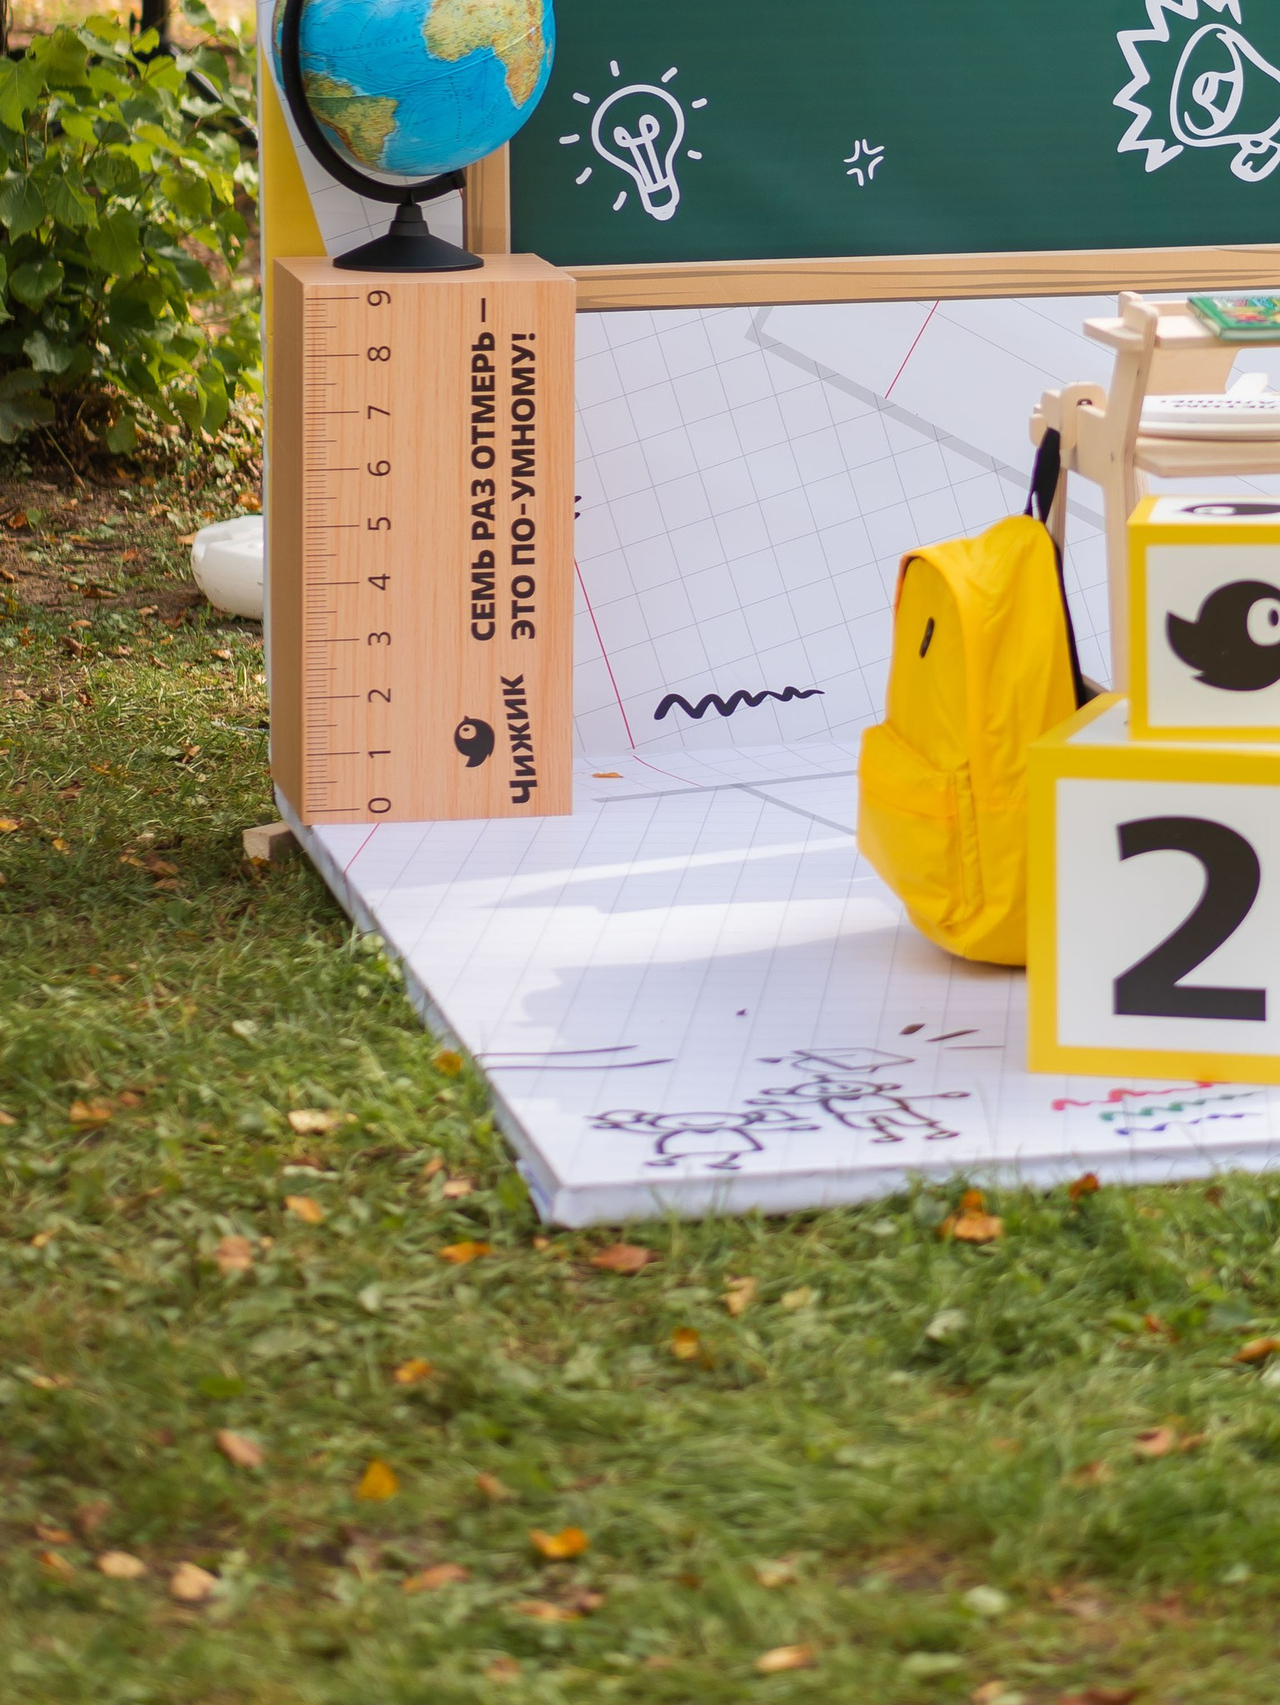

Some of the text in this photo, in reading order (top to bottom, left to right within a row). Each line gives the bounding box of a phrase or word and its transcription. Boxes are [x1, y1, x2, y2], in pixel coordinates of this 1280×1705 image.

[471, 331, 496, 470] ОТМЕРЬ
[511, 332, 536, 640] ЭТО ПО-УМНОМУ!
[367, 290, 392, 814] 0 1 2 3 4 5 6 7 8 9
[471, 478, 496, 540] РАЗ
[471, 549, 496, 641] СЕМЬ
[1113, 815, 1267, 1022] 2
